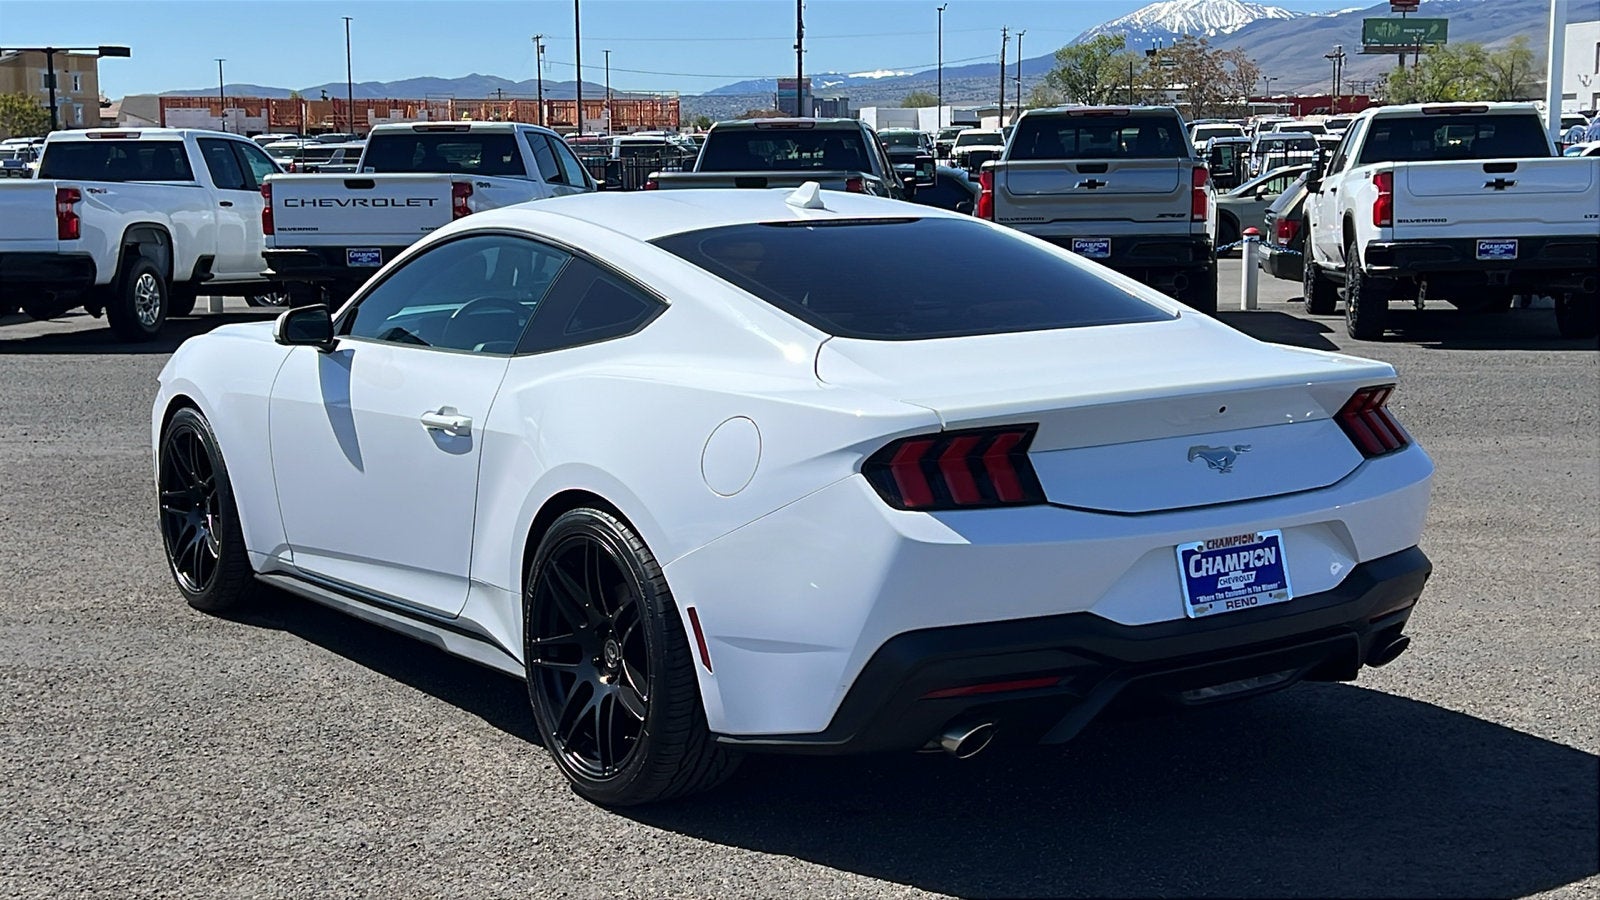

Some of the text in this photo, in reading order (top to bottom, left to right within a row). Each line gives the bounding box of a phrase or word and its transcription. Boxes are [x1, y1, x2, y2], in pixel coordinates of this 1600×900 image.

[284, 198, 439, 208] CHEVROLET
[1207, 534, 1254, 549] CHAMPION
[1189, 547, 1276, 578] CHAMPION
[1219, 573, 1254, 586] CHEVROLET
[1253, 585, 1262, 593] The
[1226, 597, 1257, 609] RENO
